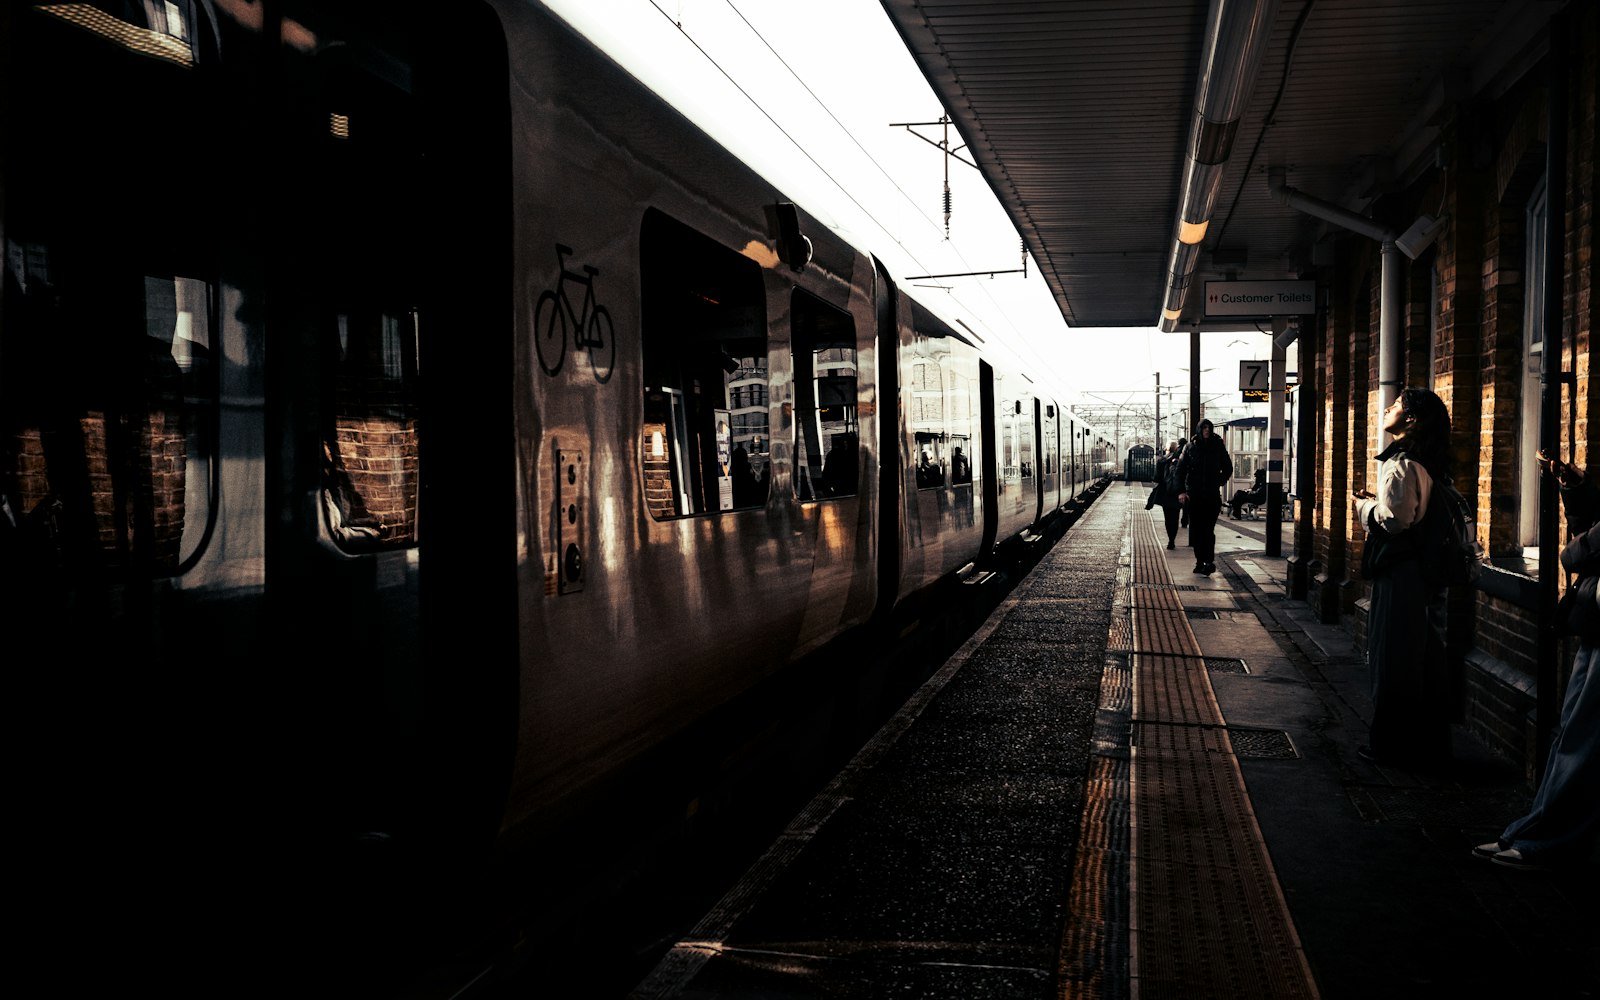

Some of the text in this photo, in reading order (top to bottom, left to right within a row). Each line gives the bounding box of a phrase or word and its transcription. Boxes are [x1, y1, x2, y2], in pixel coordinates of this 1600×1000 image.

[1221, 292, 1312, 303] Customer Toilets
[1246, 365, 1261, 386] 7
